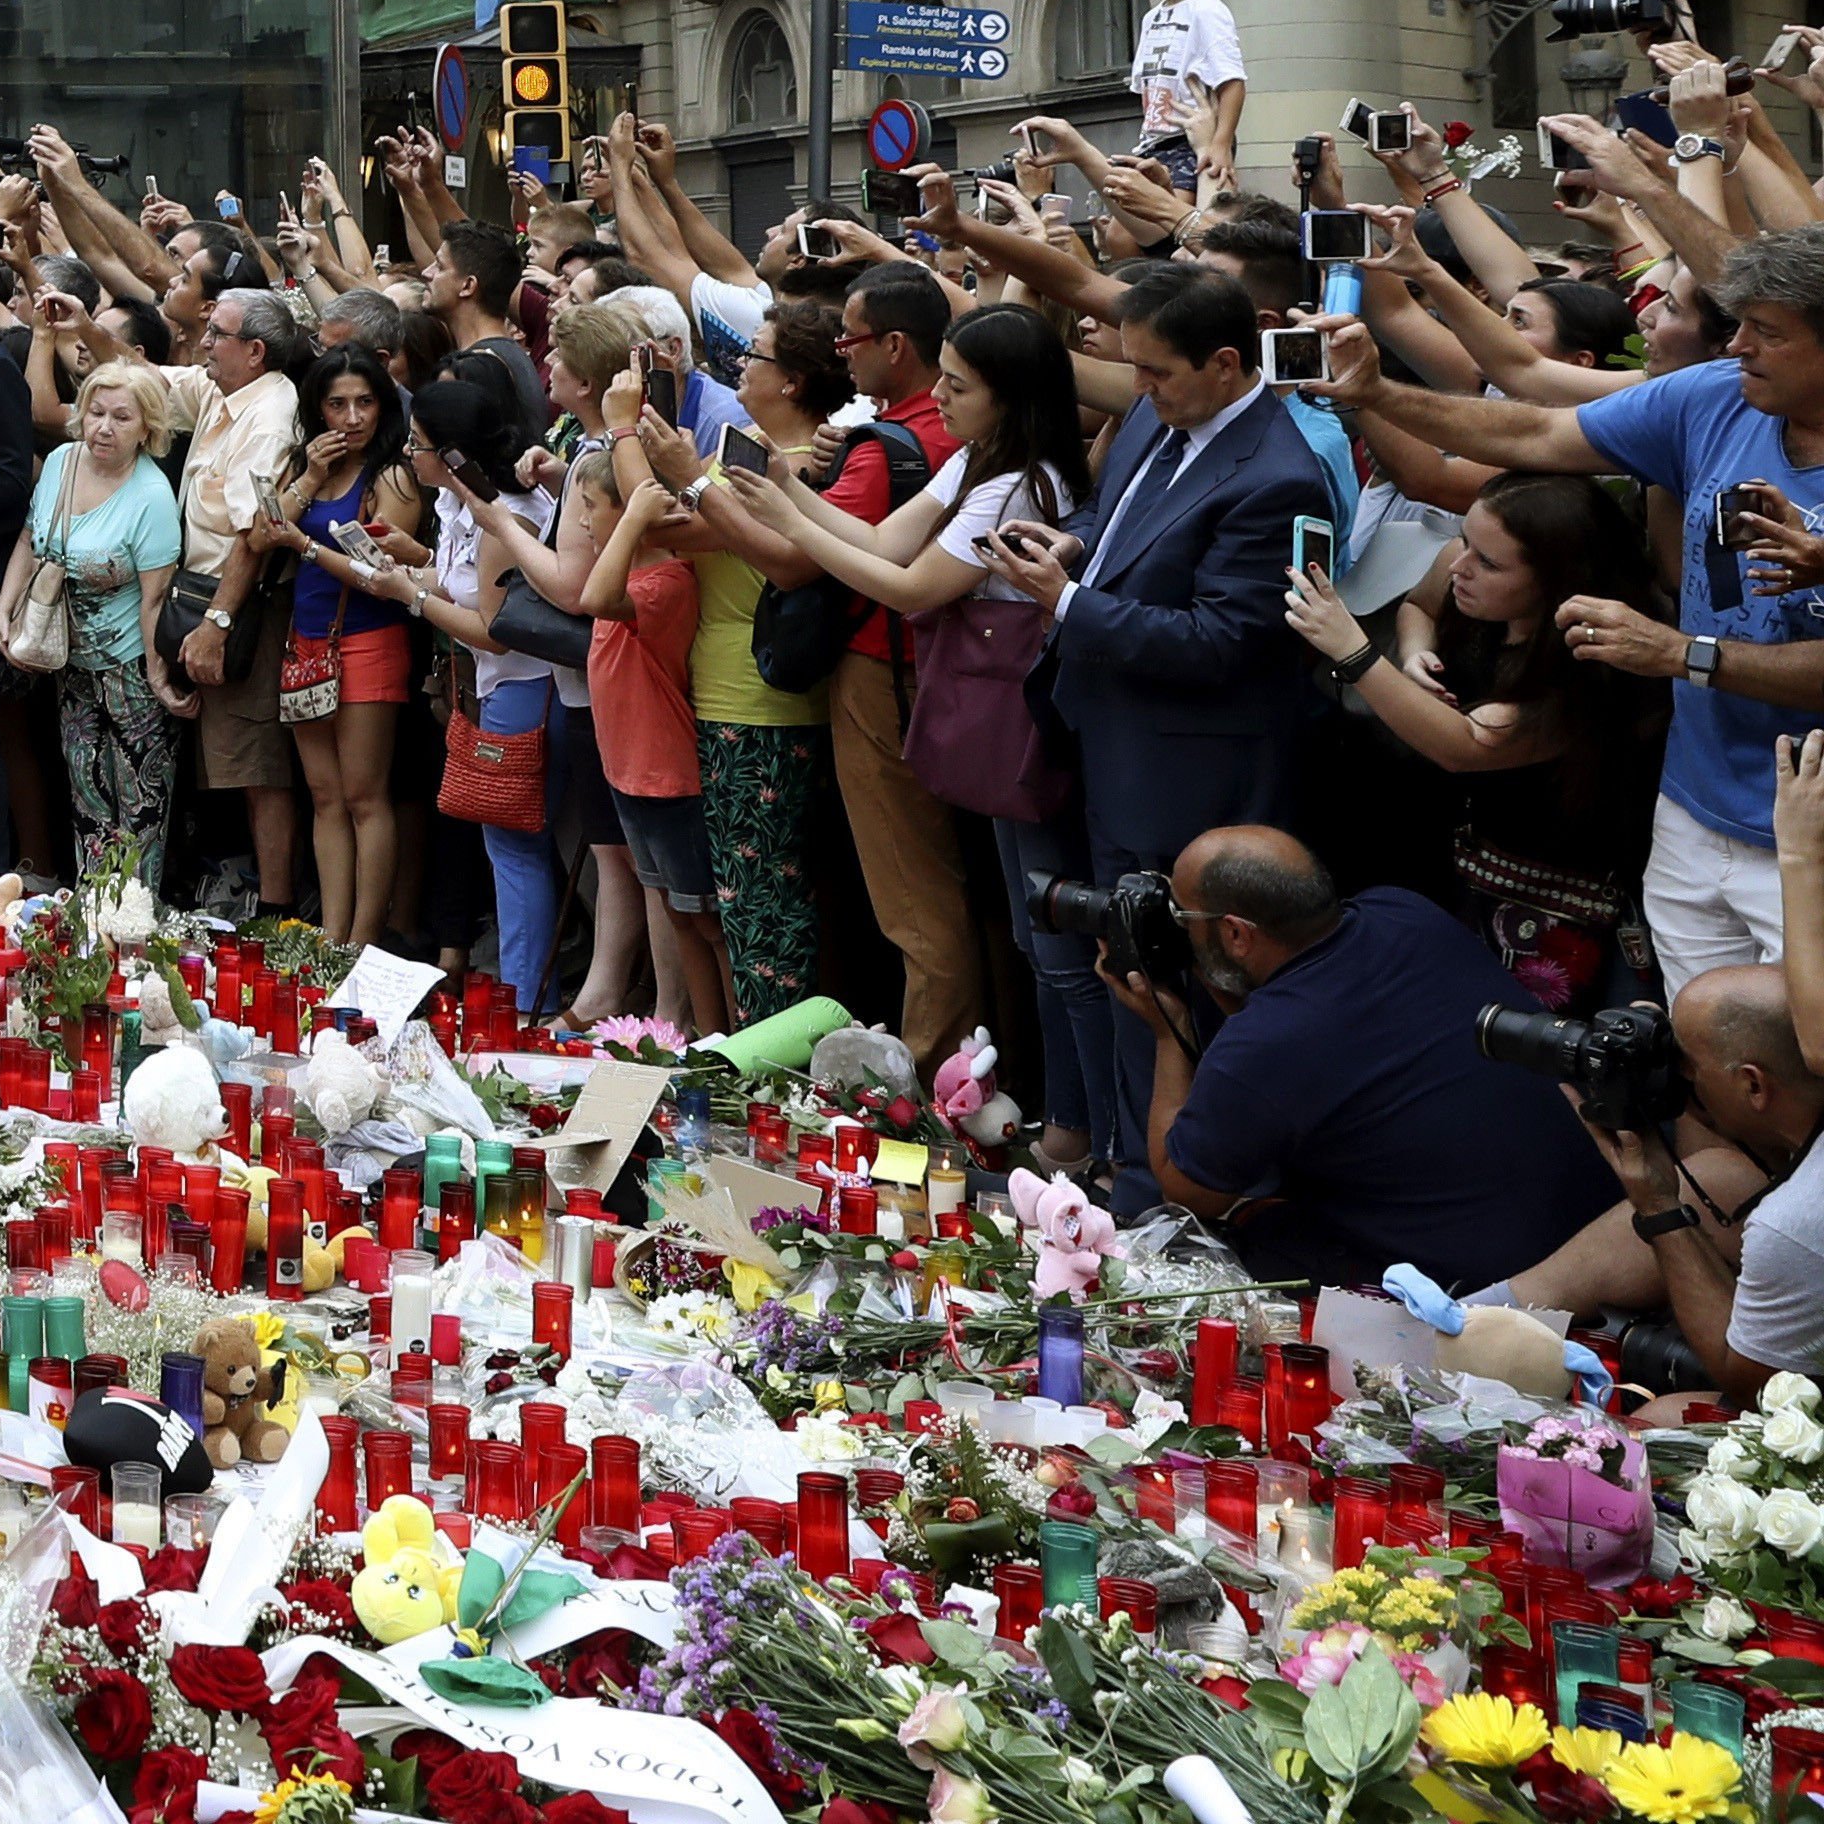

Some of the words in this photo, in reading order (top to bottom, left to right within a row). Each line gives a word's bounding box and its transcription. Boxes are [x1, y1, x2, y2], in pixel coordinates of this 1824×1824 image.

[906, 6, 918, 15] C.
[919, 7, 940, 17] Sant
[941, 8, 960, 18] Pau
[878, 15, 888, 24] Pl.
[892, 16, 931, 27] Salvador
[881, 44, 915, 56] Rambla
[917, 46, 931, 56] del
[933, 48, 958, 58] Raval
[890, 59, 908, 69] Sant
[909, 61, 922, 70] Pau
[923, 62, 935, 71] del
[589, 1746, 749, 1818] TODOS
